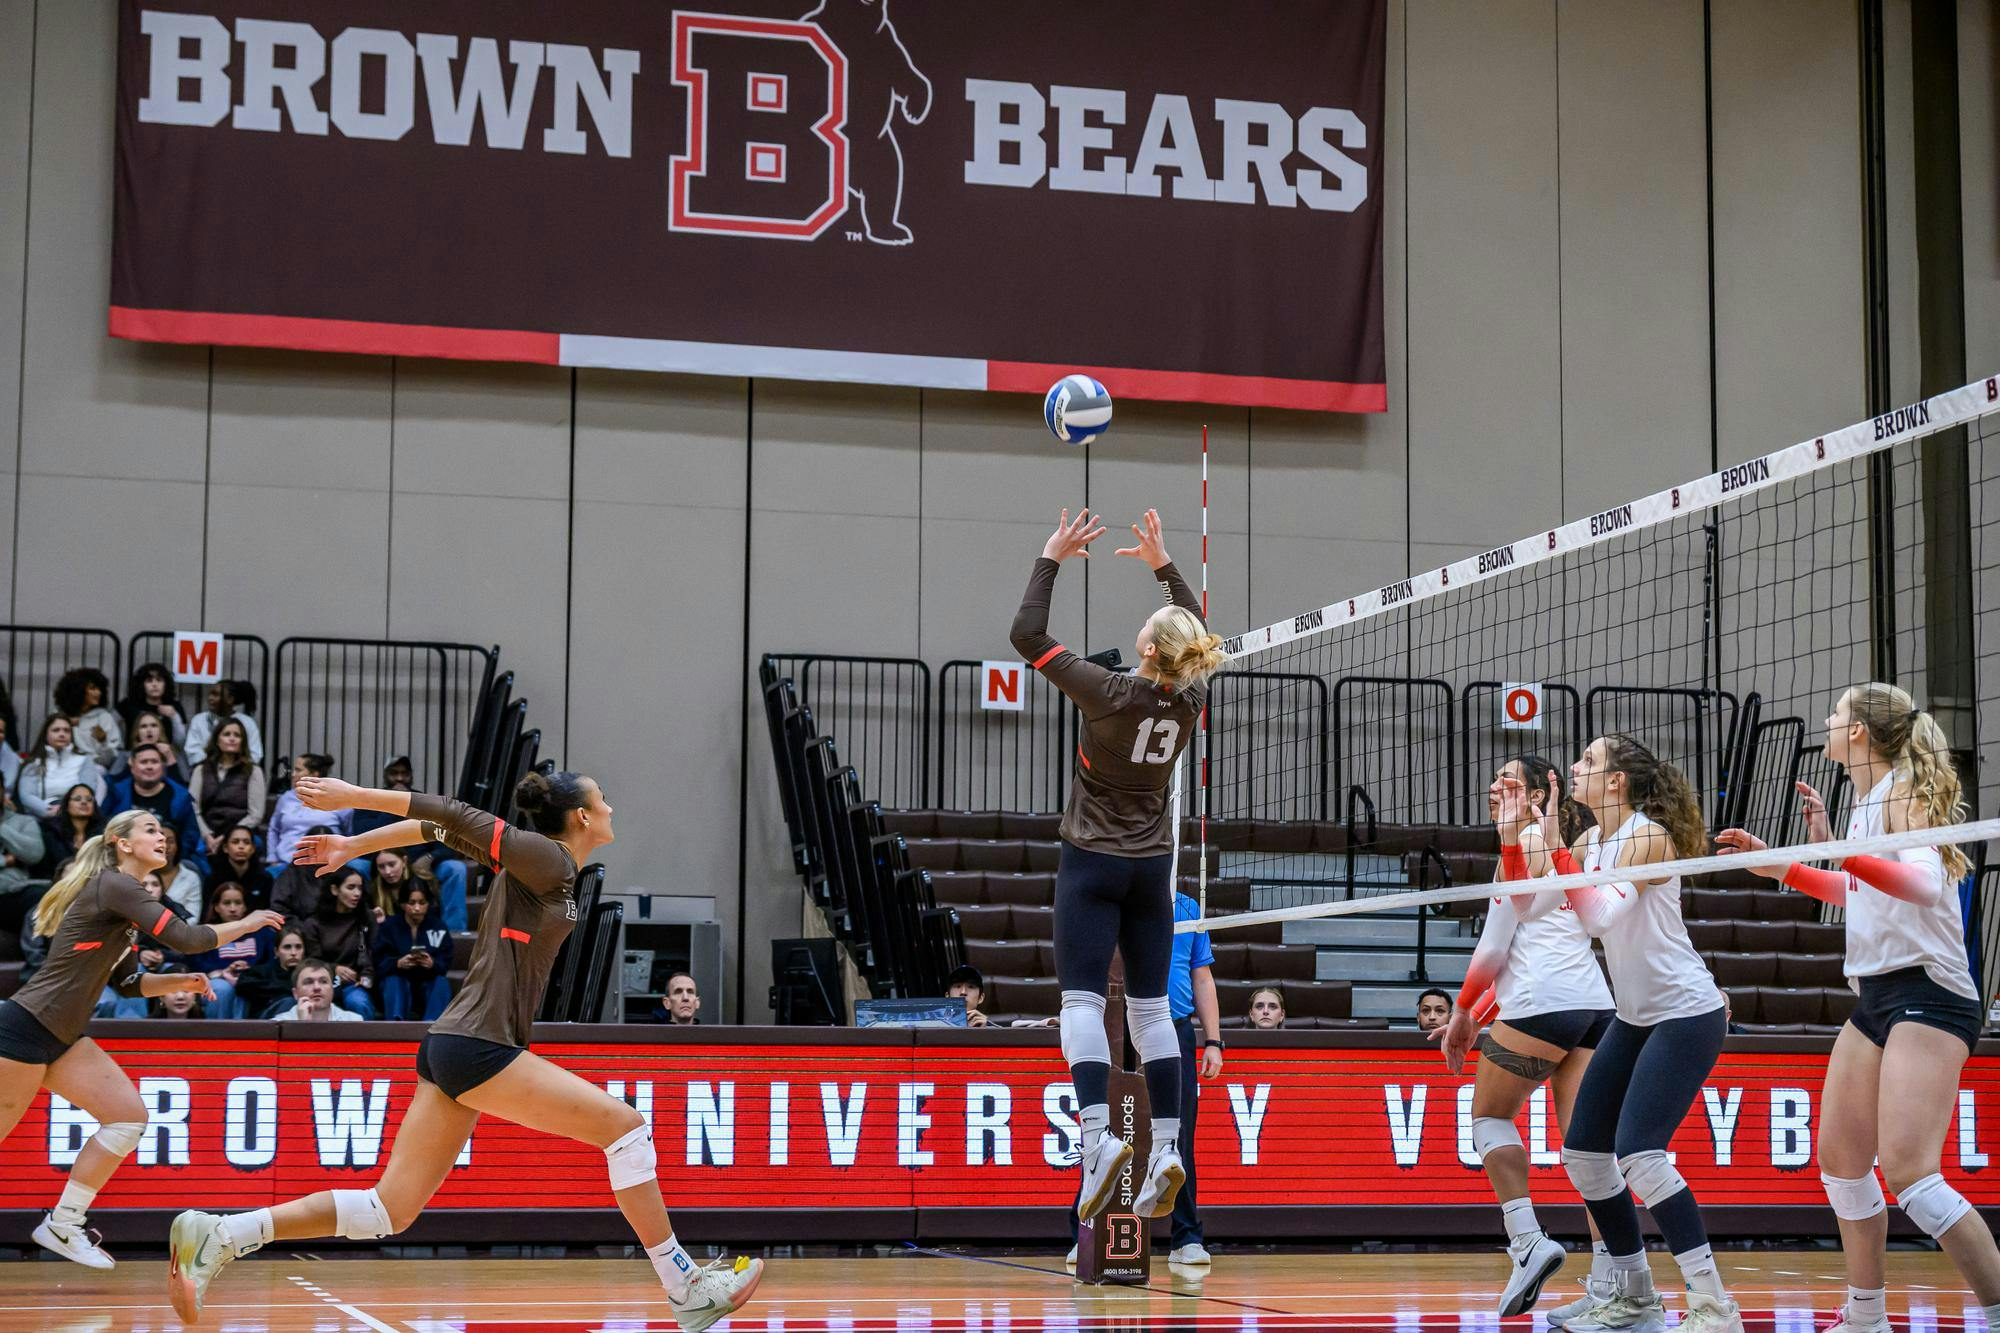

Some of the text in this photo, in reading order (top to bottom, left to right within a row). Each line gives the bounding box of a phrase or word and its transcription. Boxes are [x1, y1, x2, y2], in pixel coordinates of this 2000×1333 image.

[138, 10, 1367, 212] BROWN BEARS
[668, 10, 849, 241] B
[845, 231, 863, 242] TM
[1294, 609, 1324, 634] BROWN
[1348, 599, 1355, 617] B
[1380, 579, 1414, 606] BROWN
[1441, 568, 1449, 587] B
[1478, 545, 1514, 574] BROWN
[1548, 530, 1556, 550] B
[1590, 504, 1633, 537] BROWN
[1671, 488, 1680, 509] B
[1721, 457, 1770, 493] BROWN
[1815, 438, 1825, 461] B
[1873, 400, 1931, 441] BROWN
[1985, 378, 1999, 403] B
[178, 640, 217, 675] M
[988, 668, 1018, 703] N
[1505, 689, 1538, 722] O
[1131, 717, 1180, 764] 13
[426, 929, 446, 948] W
[49, 1077, 472, 1166] BROW
[1106, 1213, 1142, 1259] B
